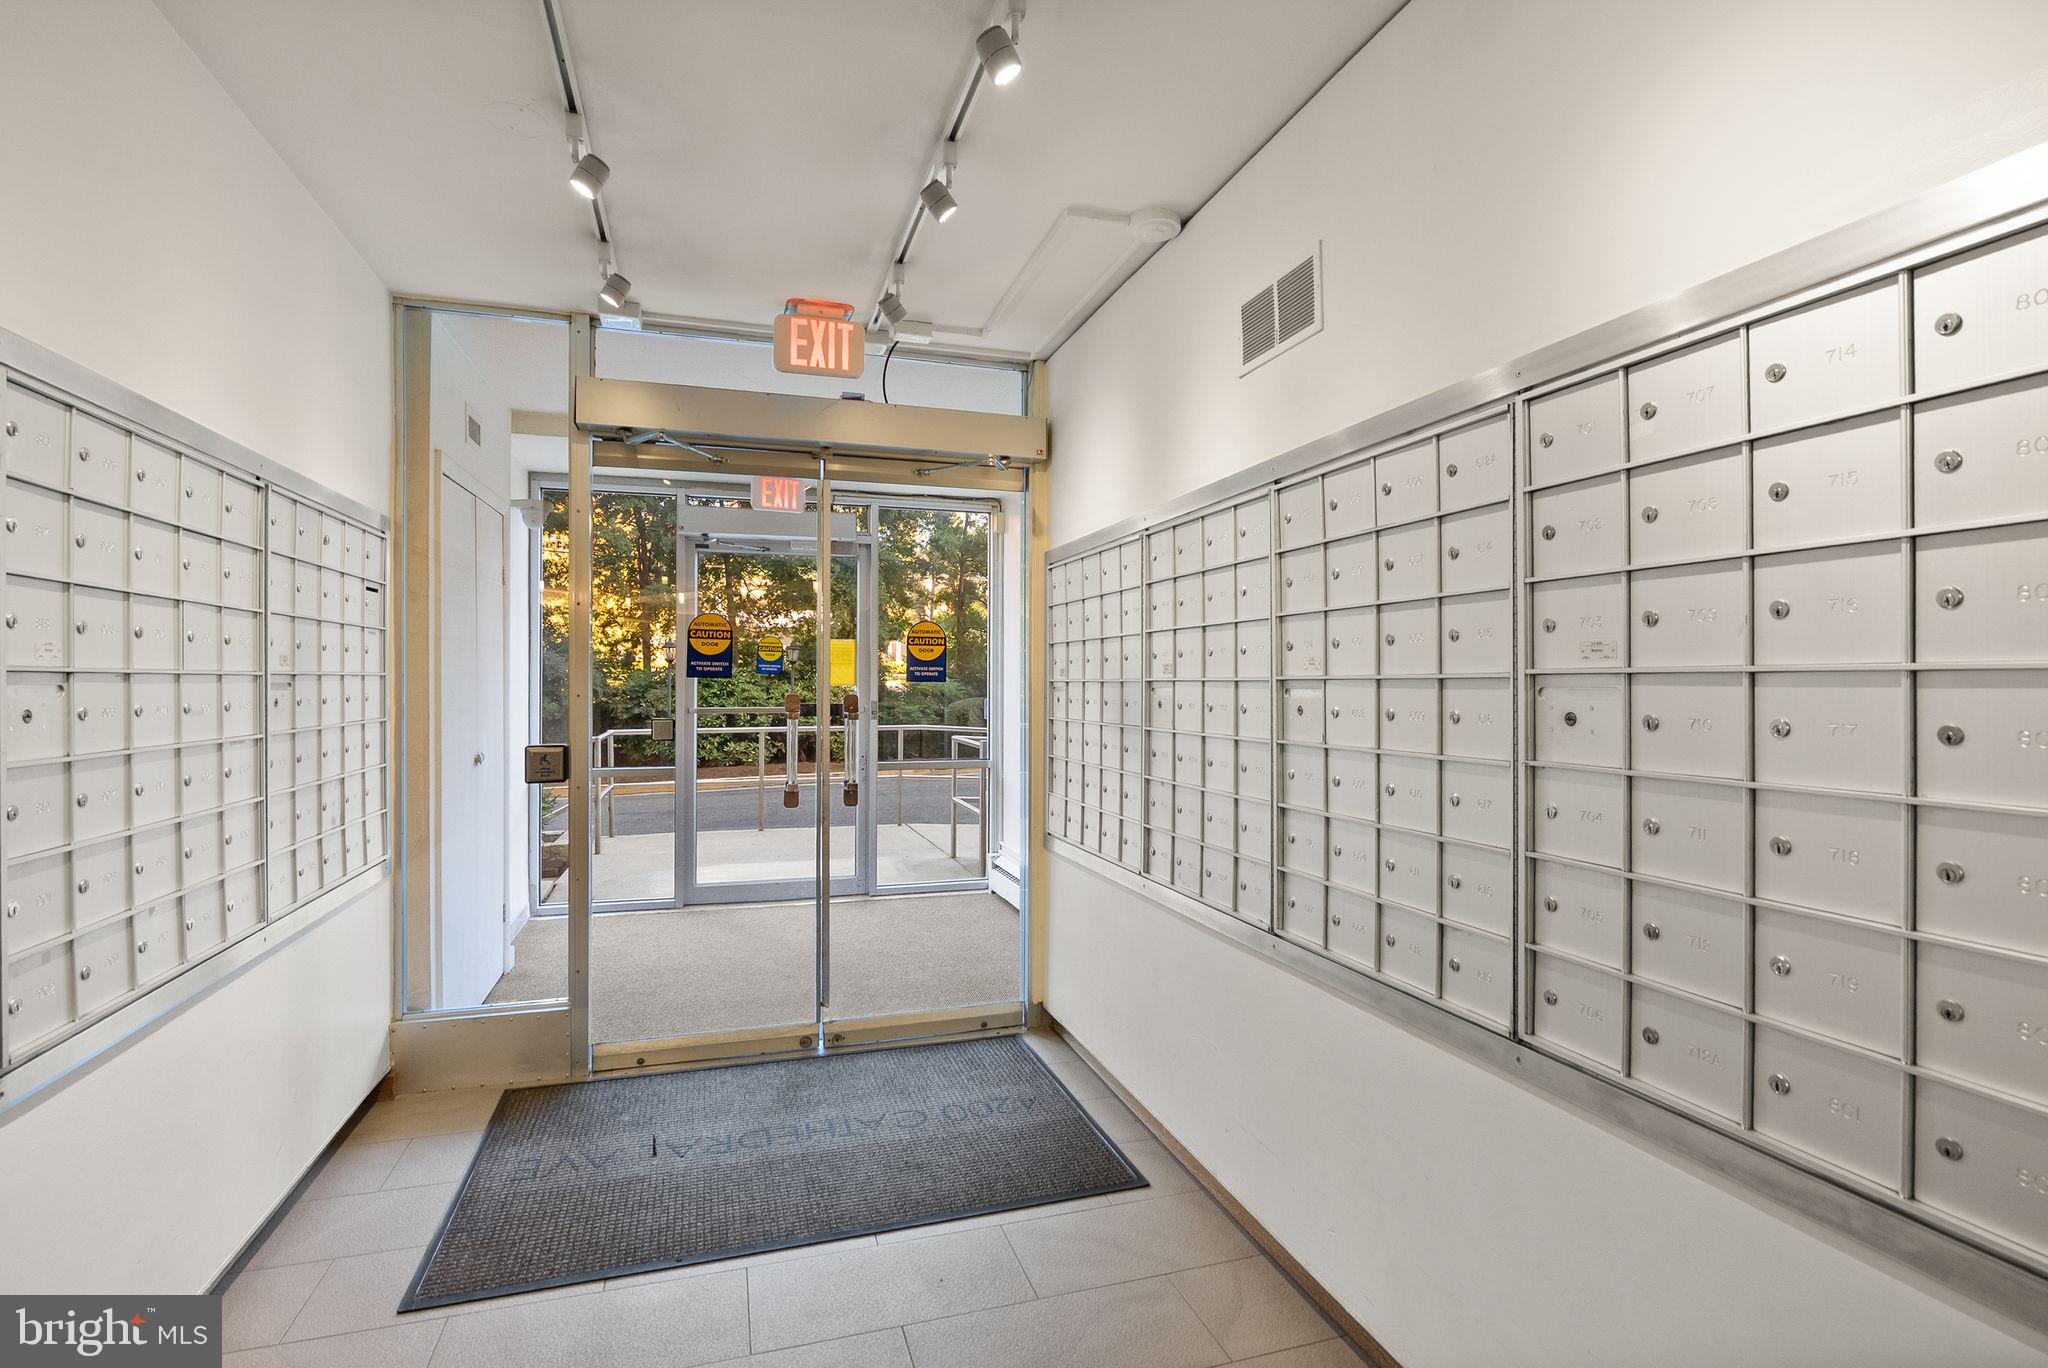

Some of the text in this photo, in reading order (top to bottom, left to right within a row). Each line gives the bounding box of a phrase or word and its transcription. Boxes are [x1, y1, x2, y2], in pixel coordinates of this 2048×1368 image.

[790, 317, 854, 370] EXIT
[1825, 343, 1858, 364] 714
[1685, 385, 1715, 404] 707
[1827, 470, 1858, 487] 715
[760, 477, 799, 510] EXIT
[1687, 496, 1719, 512] 708
[1579, 615, 1602, 629] 703
[1687, 607, 1718, 622] 709
[1829, 723, 1858, 737] 717
[1579, 809, 1602, 823] 704
[1687, 827, 1706, 841] 711
[1828, 847, 1860, 866] 718
[1579, 906, 1603, 923] 705
[1687, 935, 1712, 952] 712
[1828, 972, 1859, 993] 719
[1579, 1003, 1604, 1022] 706
[1687, 1045, 1721, 1067] 712A
[1828, 1096, 1861, 1121] 801
[506, 1149, 620, 1184] AVE
